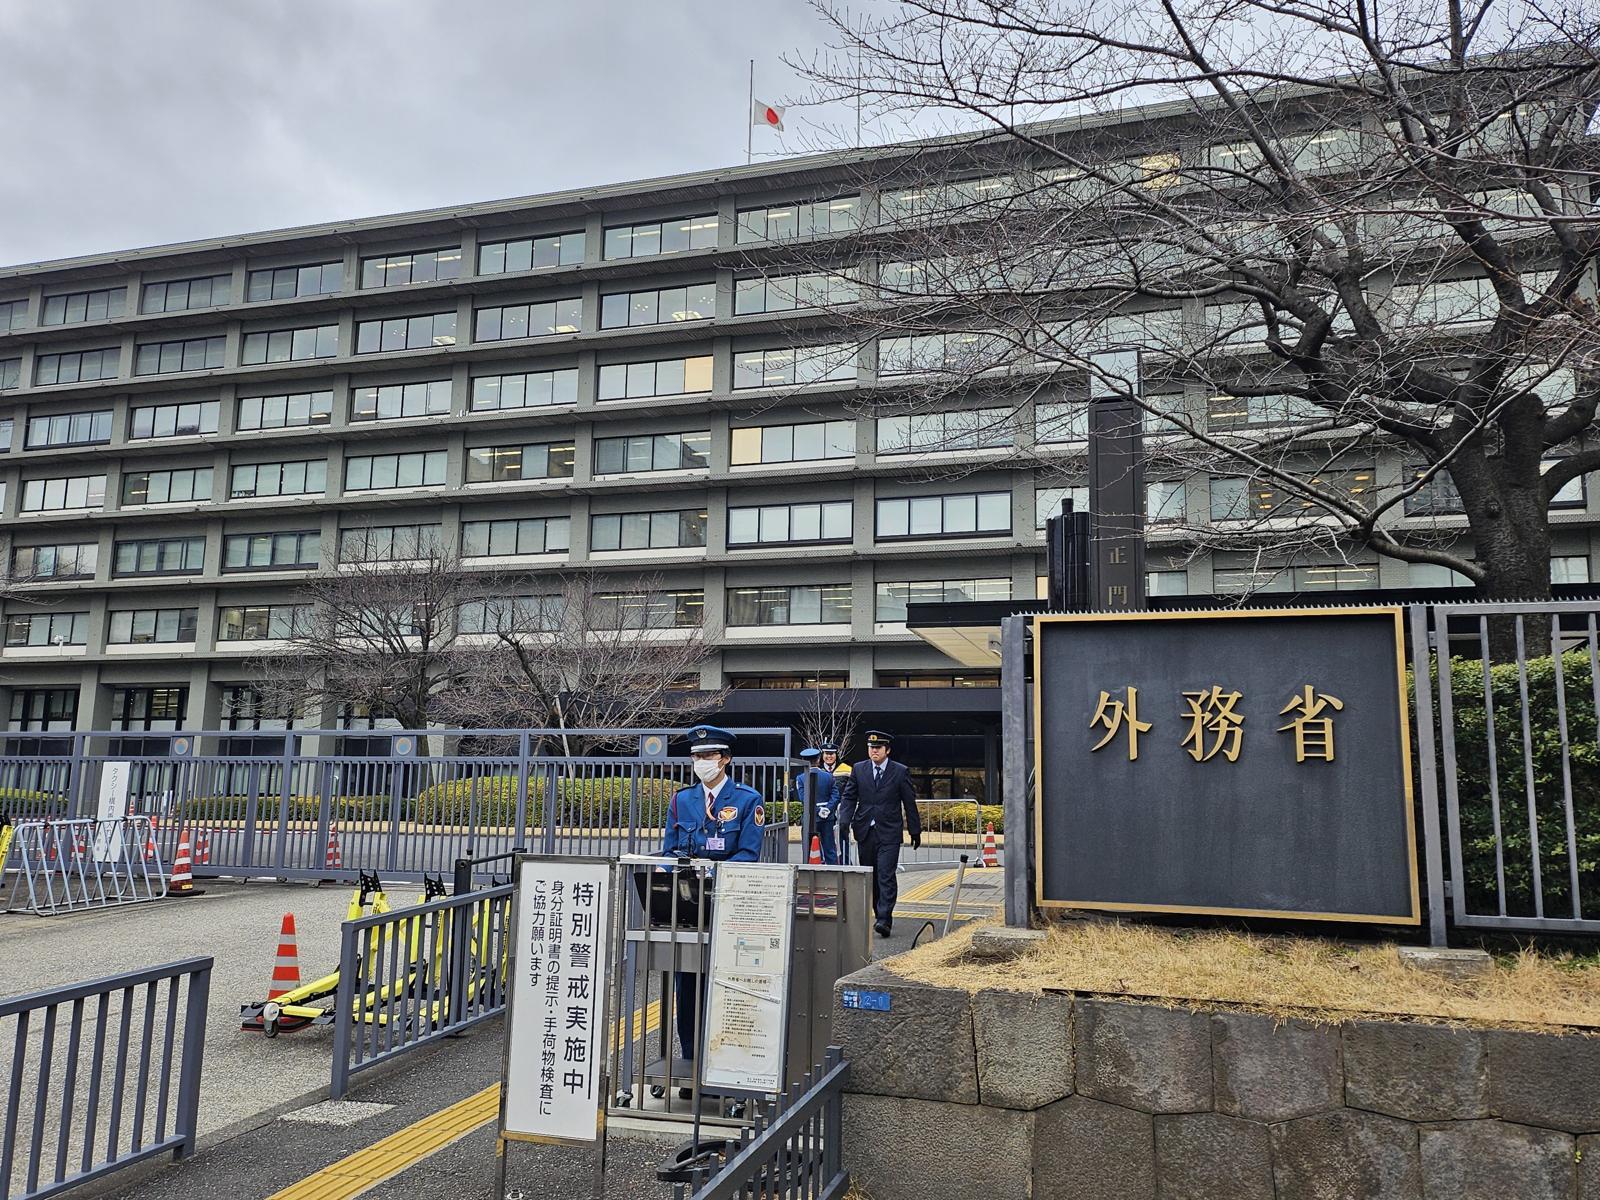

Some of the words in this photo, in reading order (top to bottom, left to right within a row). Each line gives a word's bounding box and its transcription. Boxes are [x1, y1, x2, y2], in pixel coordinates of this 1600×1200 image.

[1107, 546, 1128, 606] 正門
[1089, 684, 1344, 763] 外務省
[529, 879, 547, 987] ご協力願います
[539, 880, 565, 1116] 身分証明書の提示・手荷物検査に
[563, 881, 594, 1095] 特別警戒実施中
